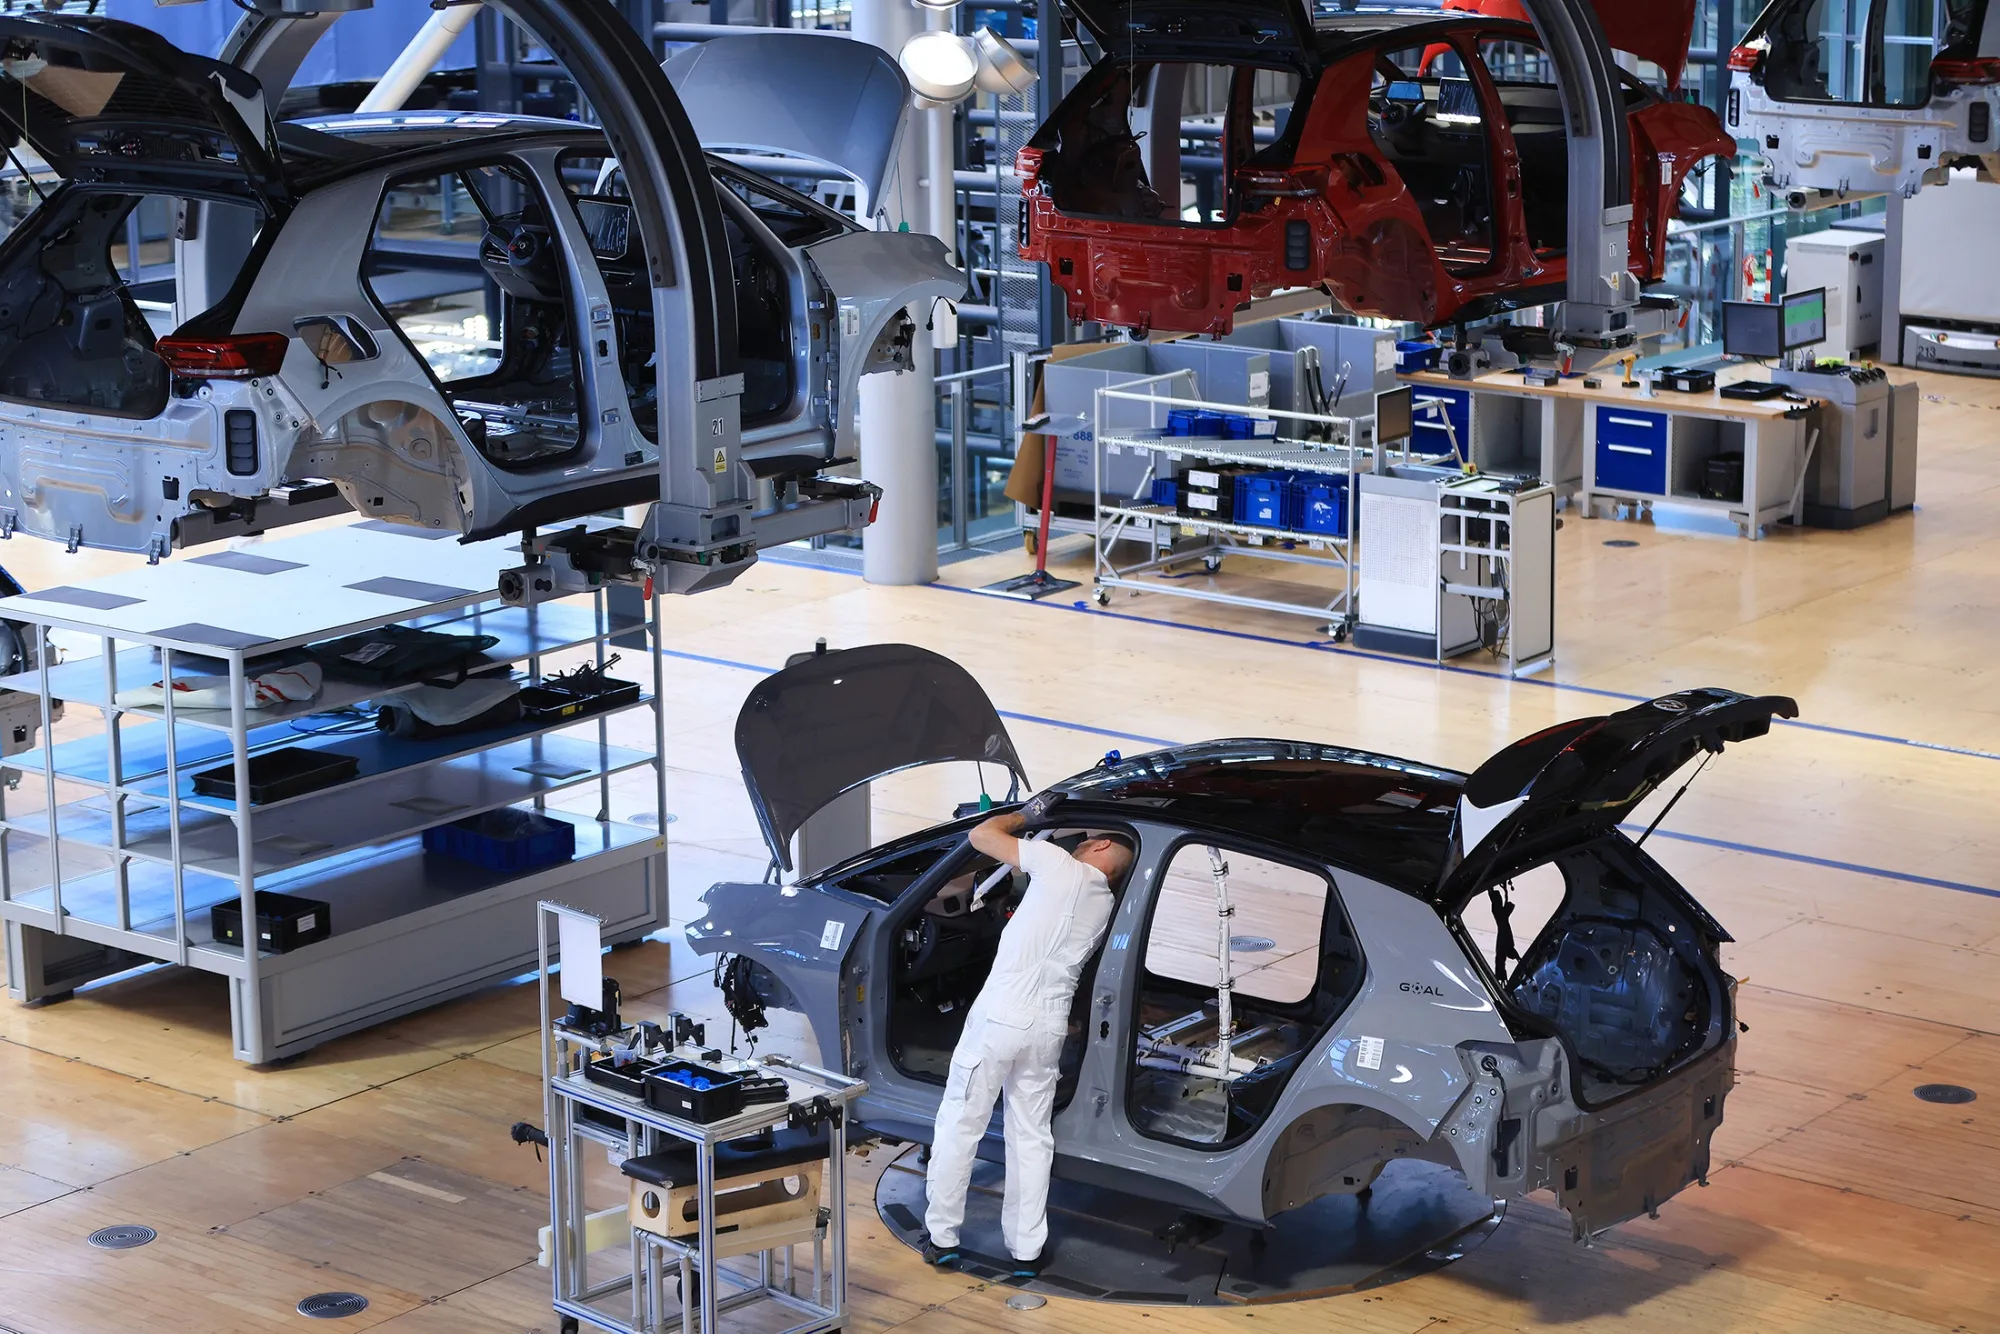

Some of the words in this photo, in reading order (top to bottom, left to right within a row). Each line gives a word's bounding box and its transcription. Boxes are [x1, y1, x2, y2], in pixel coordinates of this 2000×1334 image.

[1918, 345, 1936, 358] 213
[712, 418, 723, 436] 21
[1399, 981, 1444, 997] GOAL
